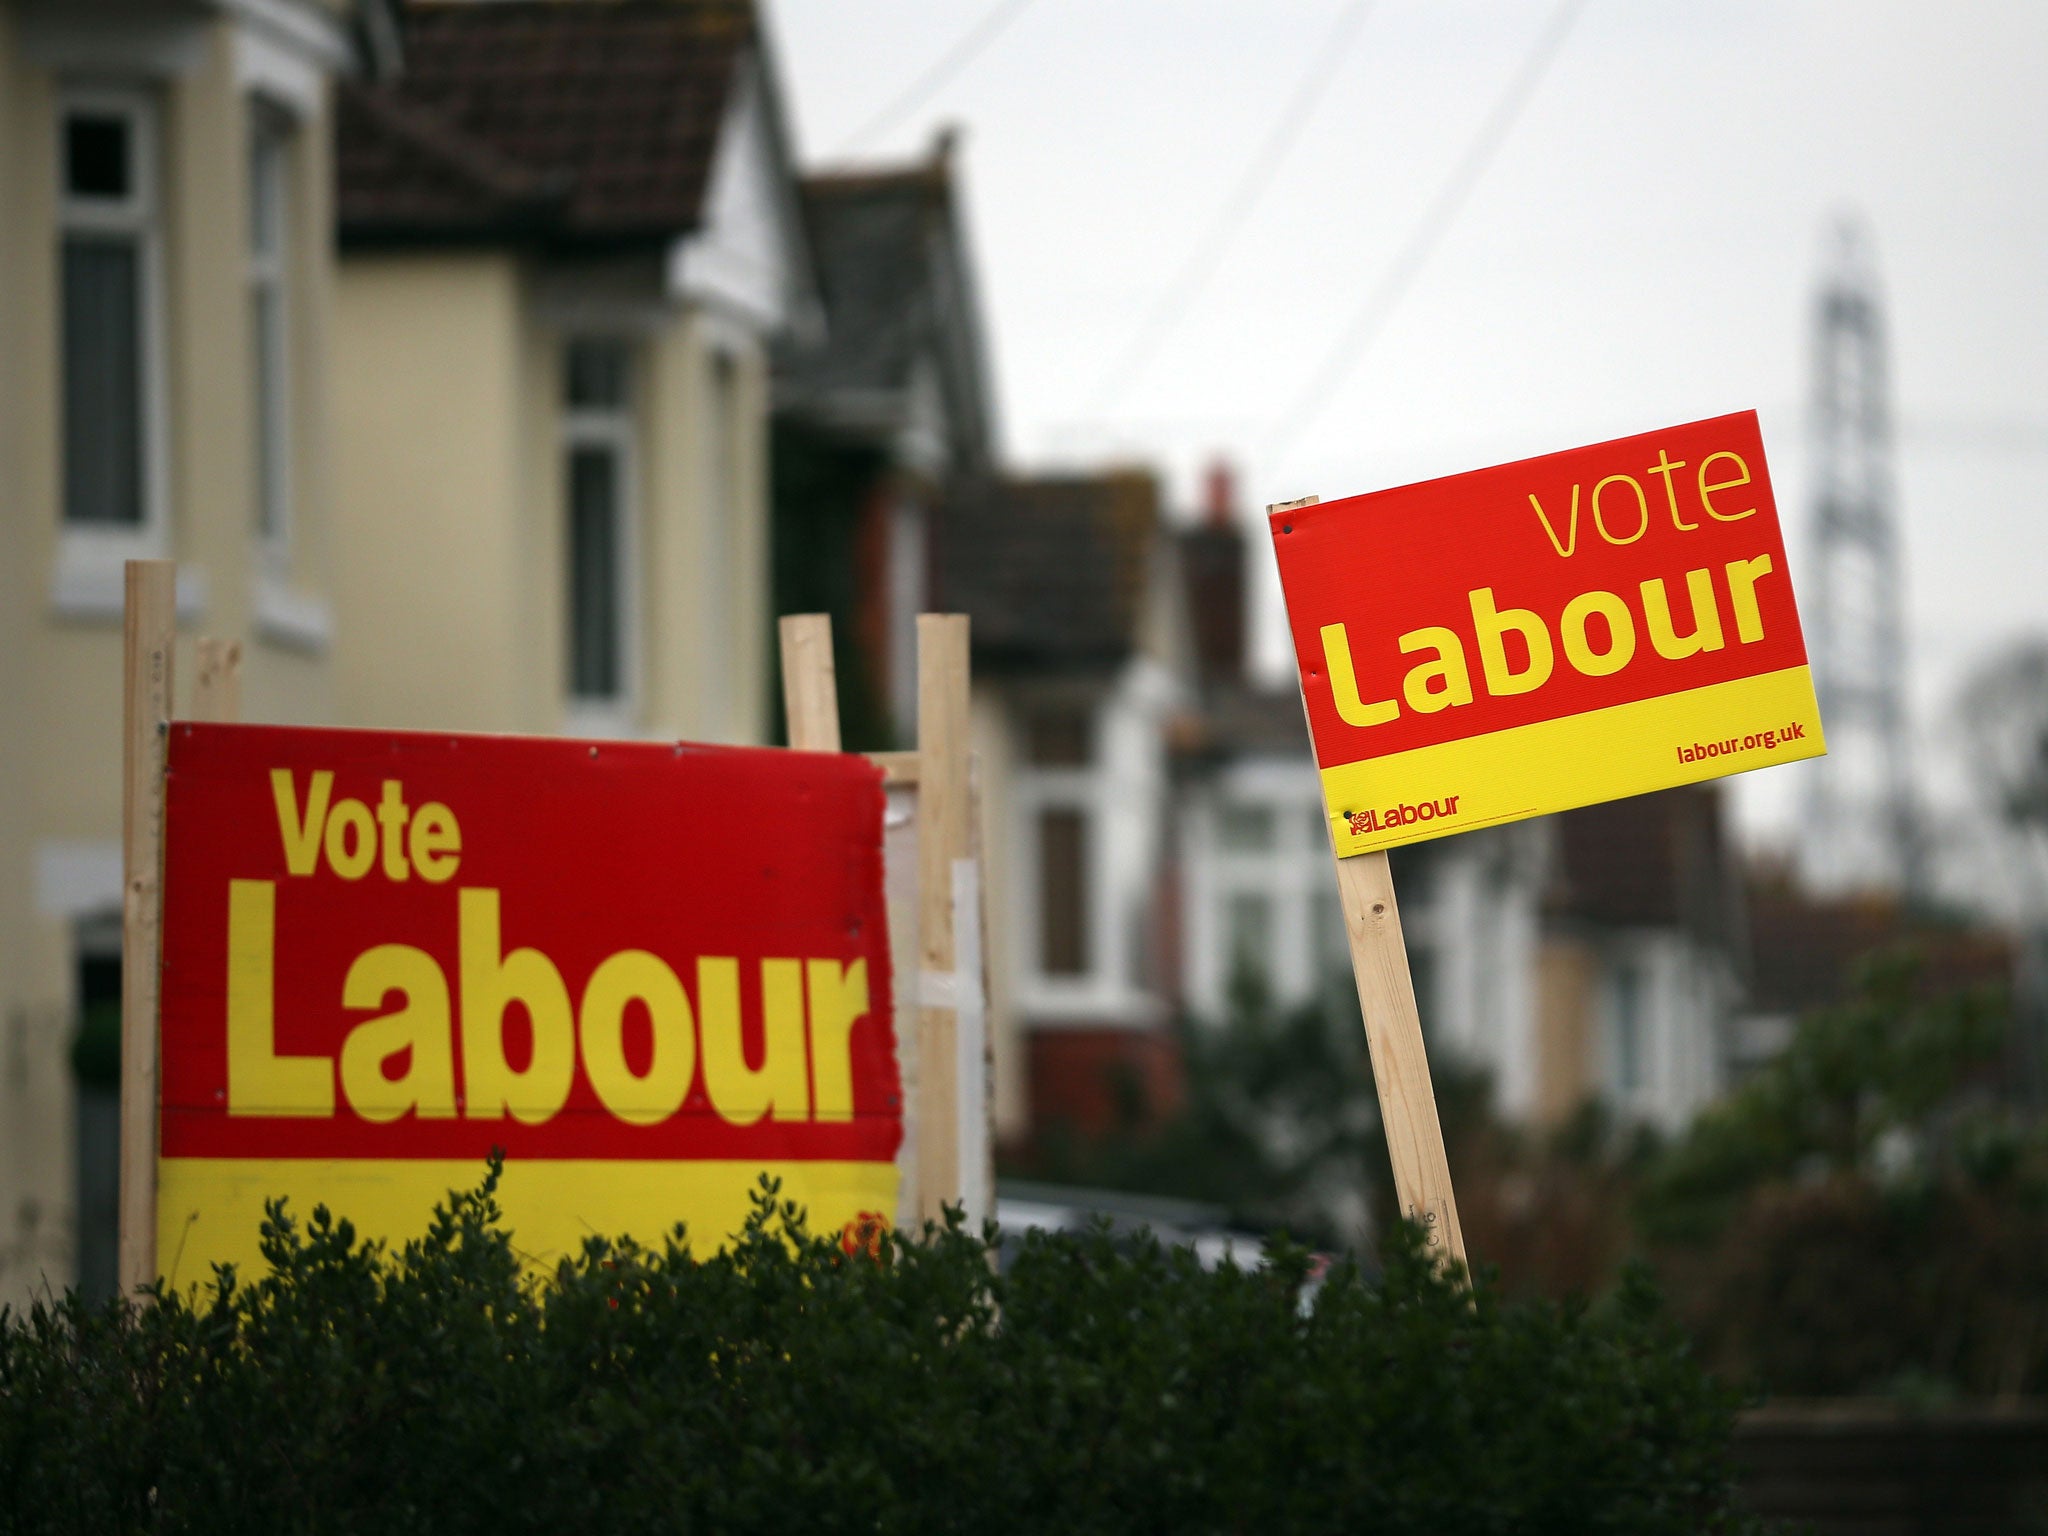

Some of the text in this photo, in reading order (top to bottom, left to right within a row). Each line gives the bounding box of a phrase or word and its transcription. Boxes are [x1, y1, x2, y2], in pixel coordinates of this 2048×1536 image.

[1527, 449, 1758, 558] vote
[1319, 553, 1774, 729] Labour
[1676, 721, 1806, 765] labour.org.uk
[269, 768, 463, 884] Vote
[1370, 795, 1460, 832] Labour
[227, 879, 871, 1126] Labour
